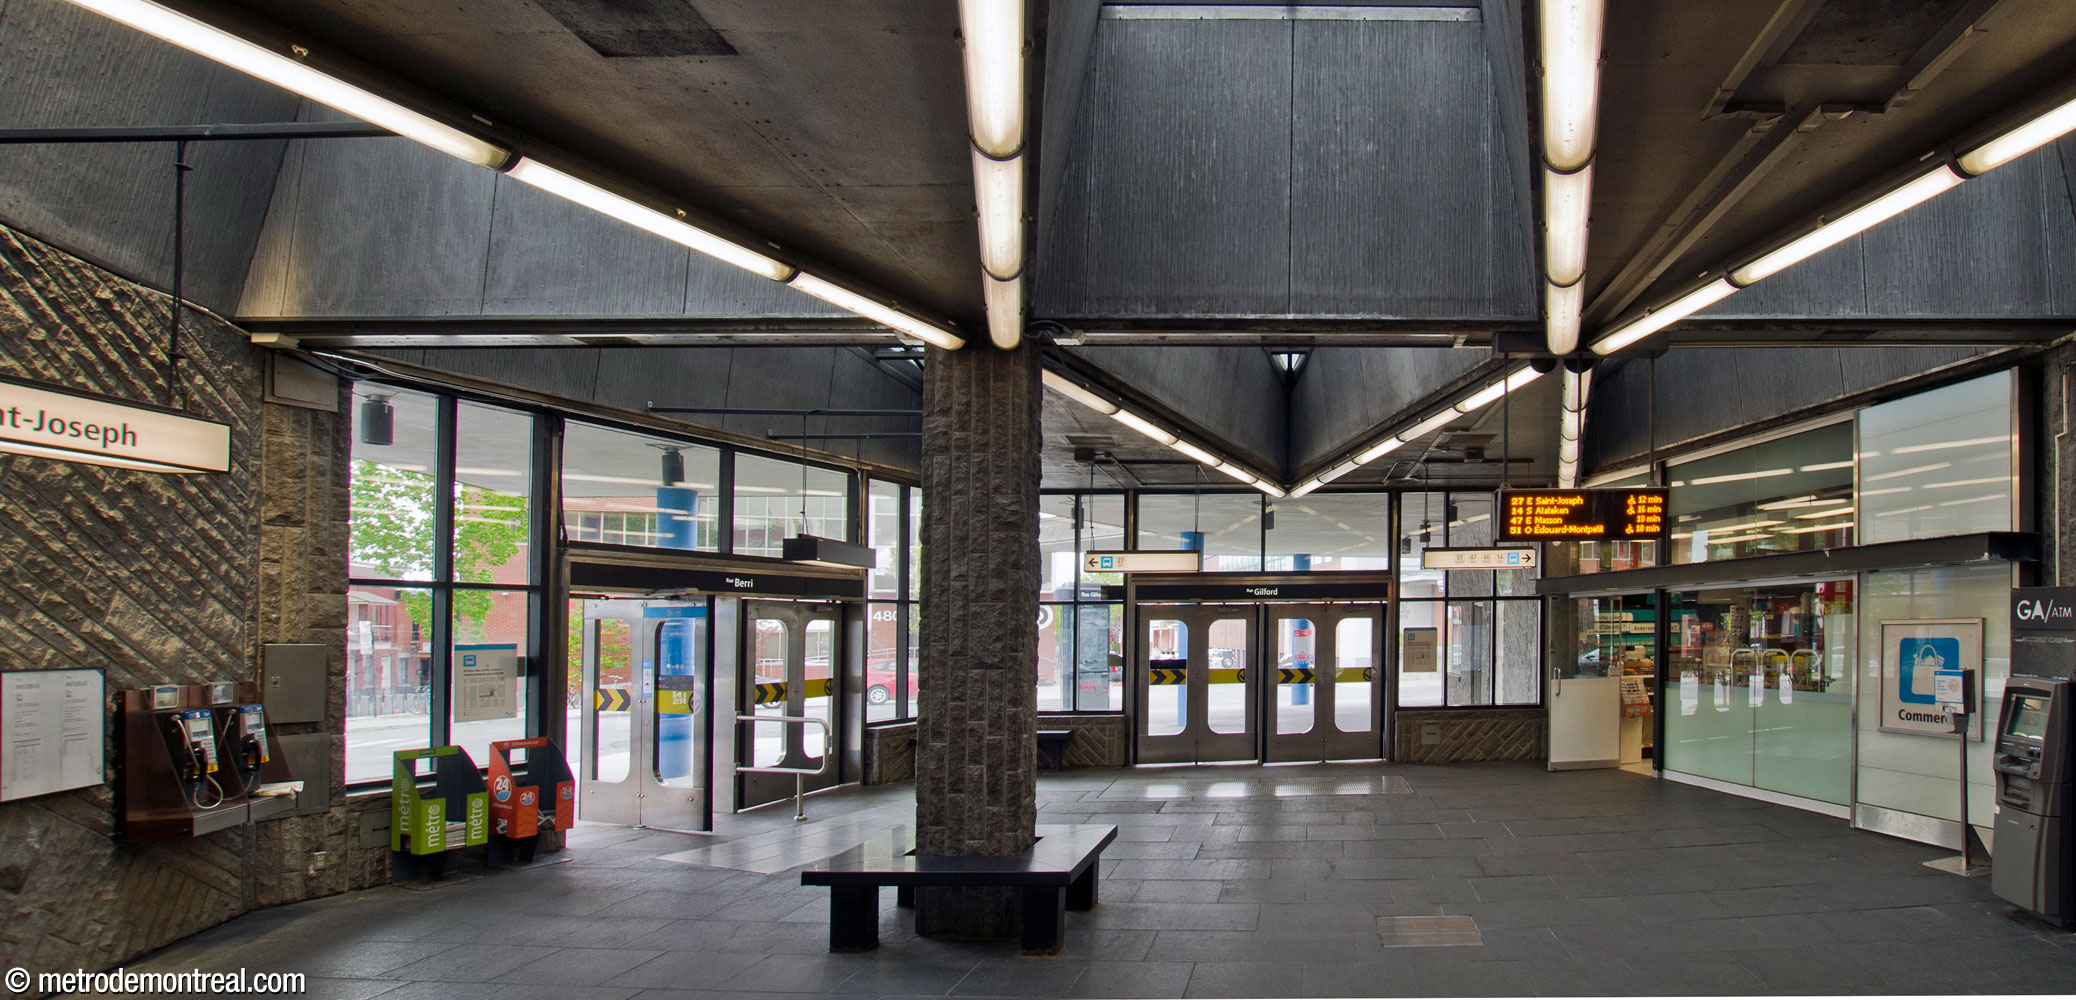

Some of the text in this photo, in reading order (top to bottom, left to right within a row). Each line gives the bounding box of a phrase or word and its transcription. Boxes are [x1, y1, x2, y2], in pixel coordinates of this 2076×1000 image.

[1511, 495, 1662, 506] 27 E Saint-Joseph 12 min
[1511, 507, 1523, 515] 14
[1526, 507, 1533, 515] S
[1647, 505, 1662, 513] min
[1510, 516, 1523, 525] 47
[1526, 516, 1532, 524] E
[1535, 516, 1563, 524] Masson
[1646, 515, 1661, 523] min
[1509, 526, 1522, 534] 51
[1524, 526, 1532, 534] O
[1645, 524, 1660, 532] min
[735, 578, 753, 587] Berri
[1254, 587, 1278, 596] Gilford
[1898, 709, 1947, 724] Commer
[496, 776, 509, 791] 24
[521, 791, 534, 800] 24
[562, 786, 573, 795] 24
